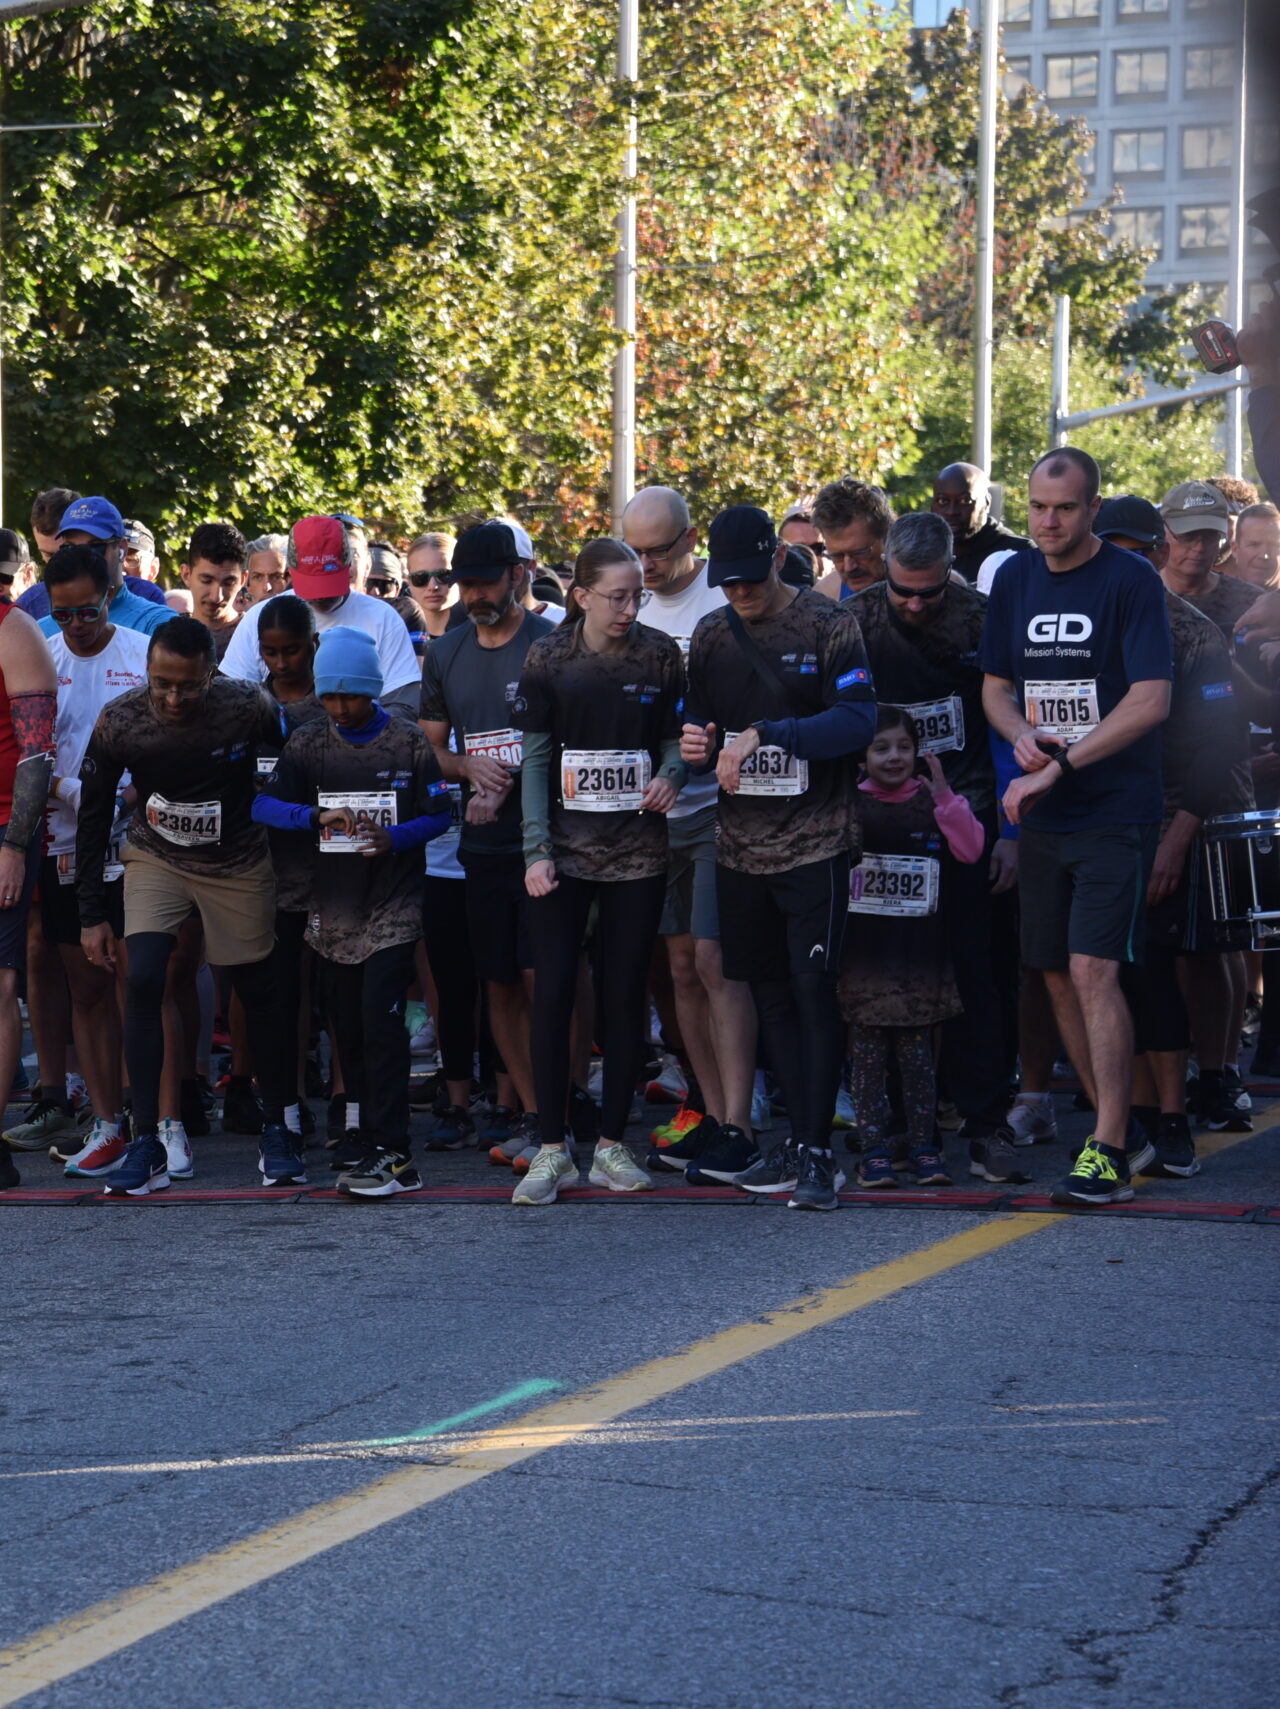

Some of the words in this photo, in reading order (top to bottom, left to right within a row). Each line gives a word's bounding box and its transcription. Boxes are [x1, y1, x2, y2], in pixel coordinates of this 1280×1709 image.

[1027, 613, 1093, 643] GD
[1024, 648, 1054, 658] Mission
[1055, 646, 1091, 658] Systems
[1039, 698, 1090, 723] 17615
[915, 713, 951, 739] 393
[471, 743, 523, 767] 690
[577, 766, 637, 791] 23614
[158, 811, 217, 835] 23844
[863, 870, 925, 897] 23392
